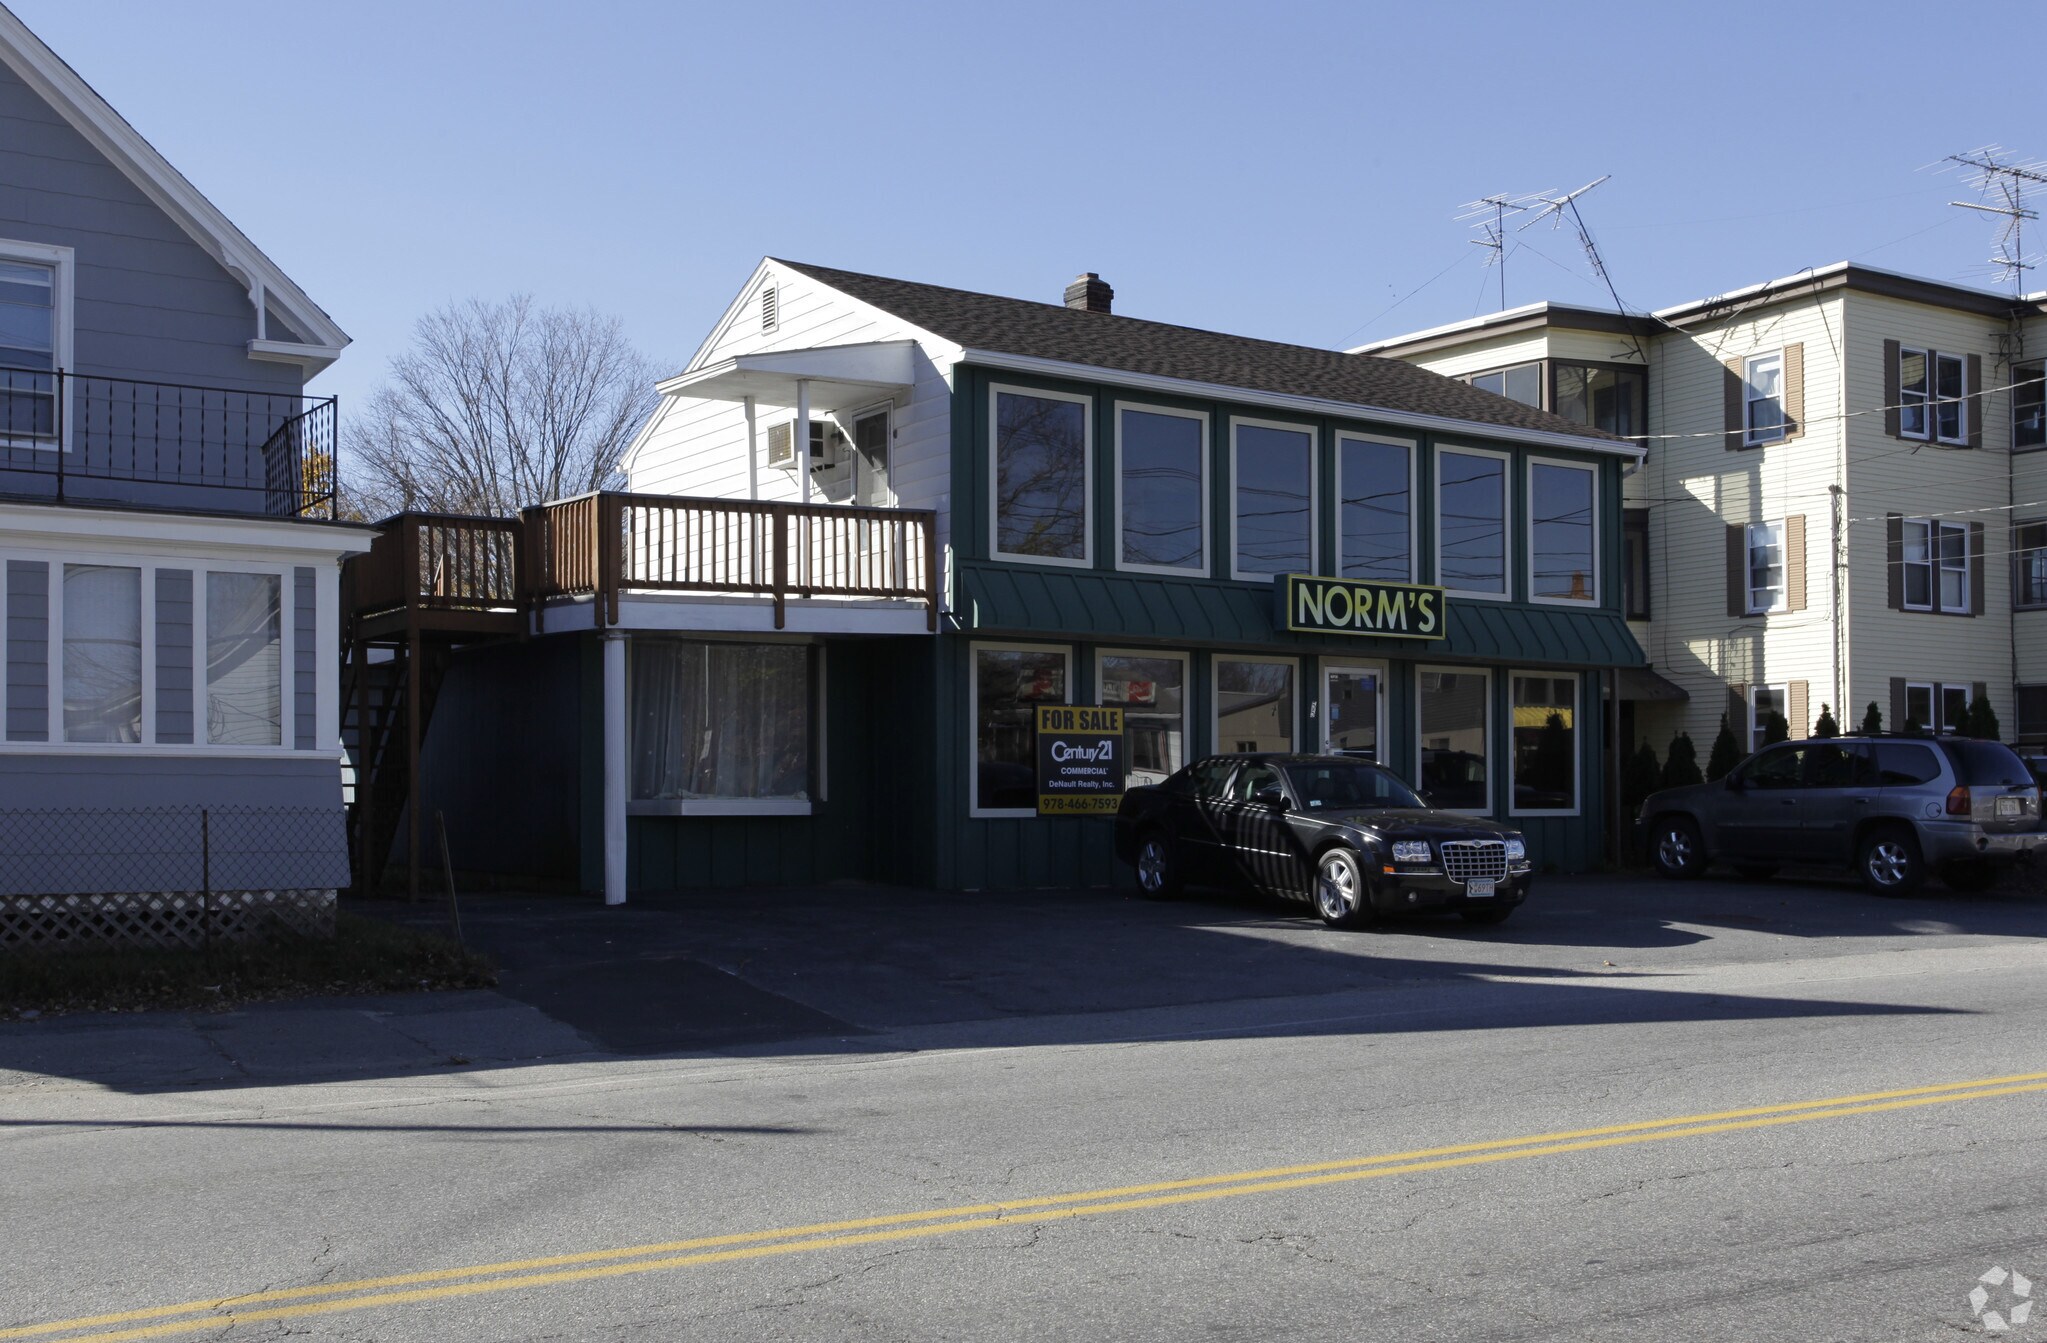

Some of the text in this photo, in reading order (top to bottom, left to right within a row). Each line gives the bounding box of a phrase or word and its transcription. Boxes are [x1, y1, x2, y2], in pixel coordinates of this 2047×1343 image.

[1299, 583, 1435, 632] NORM'S
[1042, 709, 1118, 731] FOR SALE
[1061, 767, 1107, 775] COMMERCIAL
[1049, 780, 1076, 788] DeNault
[1078, 781, 1101, 789] Realty,
[1043, 798, 1118, 809] 978-466-7593
